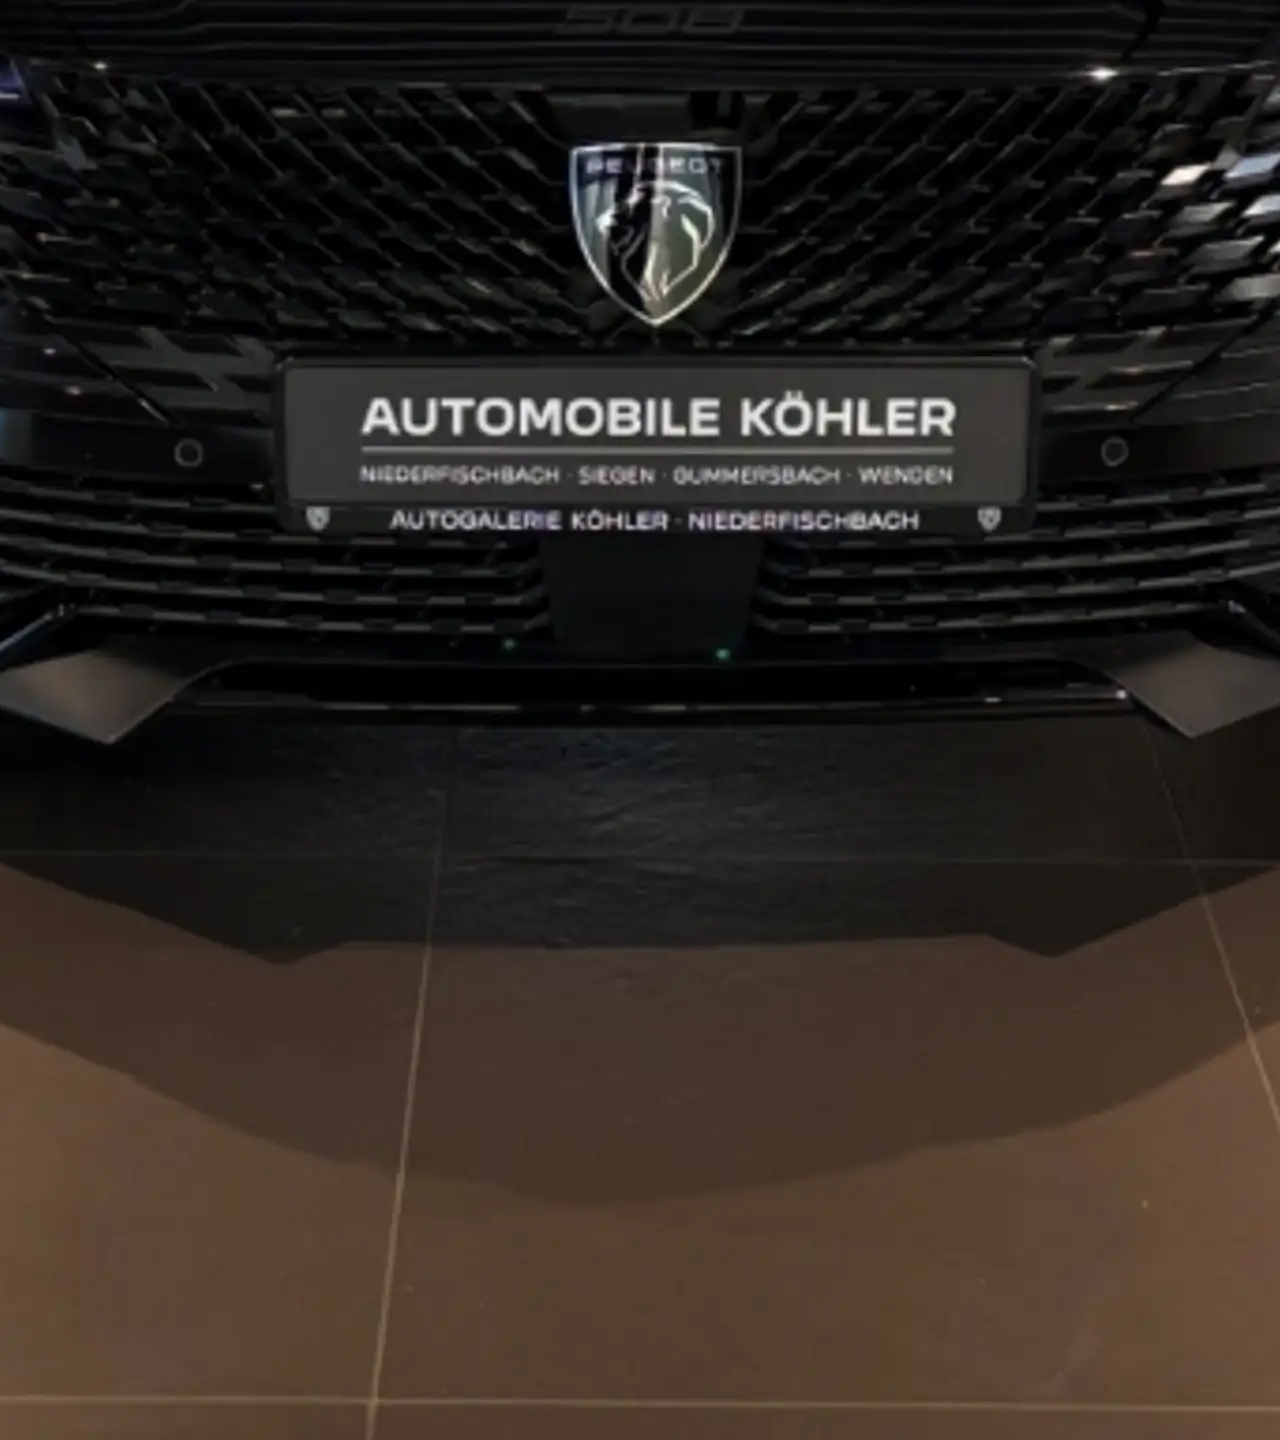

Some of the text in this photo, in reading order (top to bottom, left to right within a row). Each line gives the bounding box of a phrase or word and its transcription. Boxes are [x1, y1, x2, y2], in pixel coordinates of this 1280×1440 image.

[585, 157, 723, 174] PEEOT
[361, 390, 957, 437] AUTOMOBILE KÖHLER
[359, 465, 954, 485] NIEDERFISCHBACH SIEGEN GUMMERSBACH WENDEN
[389, 507, 919, 531] AUTOGALERIE KÖHLER NIEDERFISCHBACH
